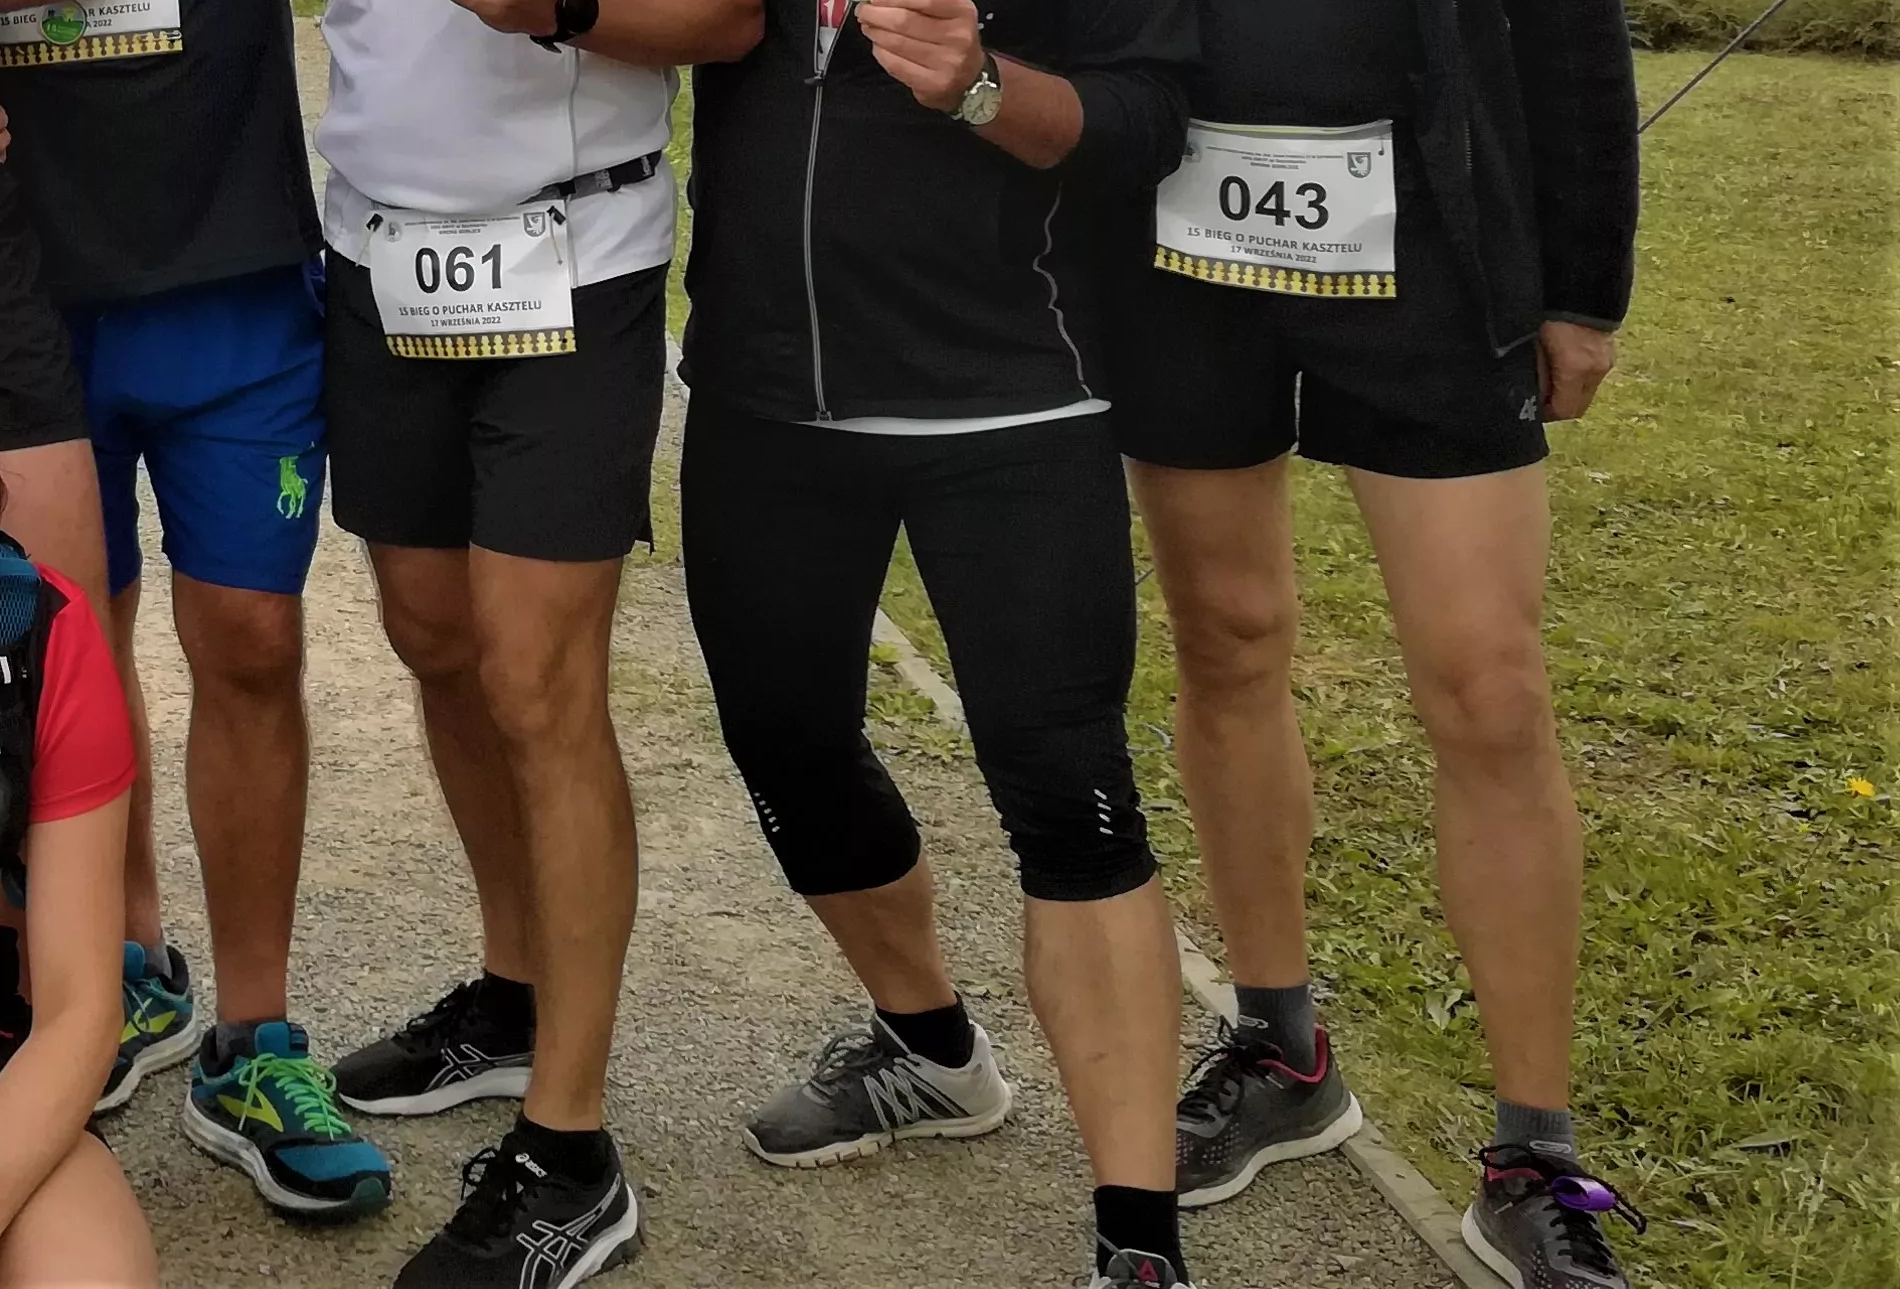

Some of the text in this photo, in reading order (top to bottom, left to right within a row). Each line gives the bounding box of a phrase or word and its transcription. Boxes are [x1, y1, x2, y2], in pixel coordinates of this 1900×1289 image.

[0, 16, 11, 26] 15
[13, 13, 37, 25] BIEG
[98, 2, 151, 17] KASZTELU
[93, 19, 112, 28] 2022
[1219, 175, 1329, 230] 043
[1187, 227, 1362, 253] 15 BIEG O PUCHAR KASZTELU
[1230, 245, 1317, 263] 17 WRZEŚNIA 2022
[415, 243, 502, 294] 061
[398, 300, 542, 316] 15 BIEG O PUCHAR KASZTELU
[430, 316, 501, 327] 17 WRZEŚNIA 2022
